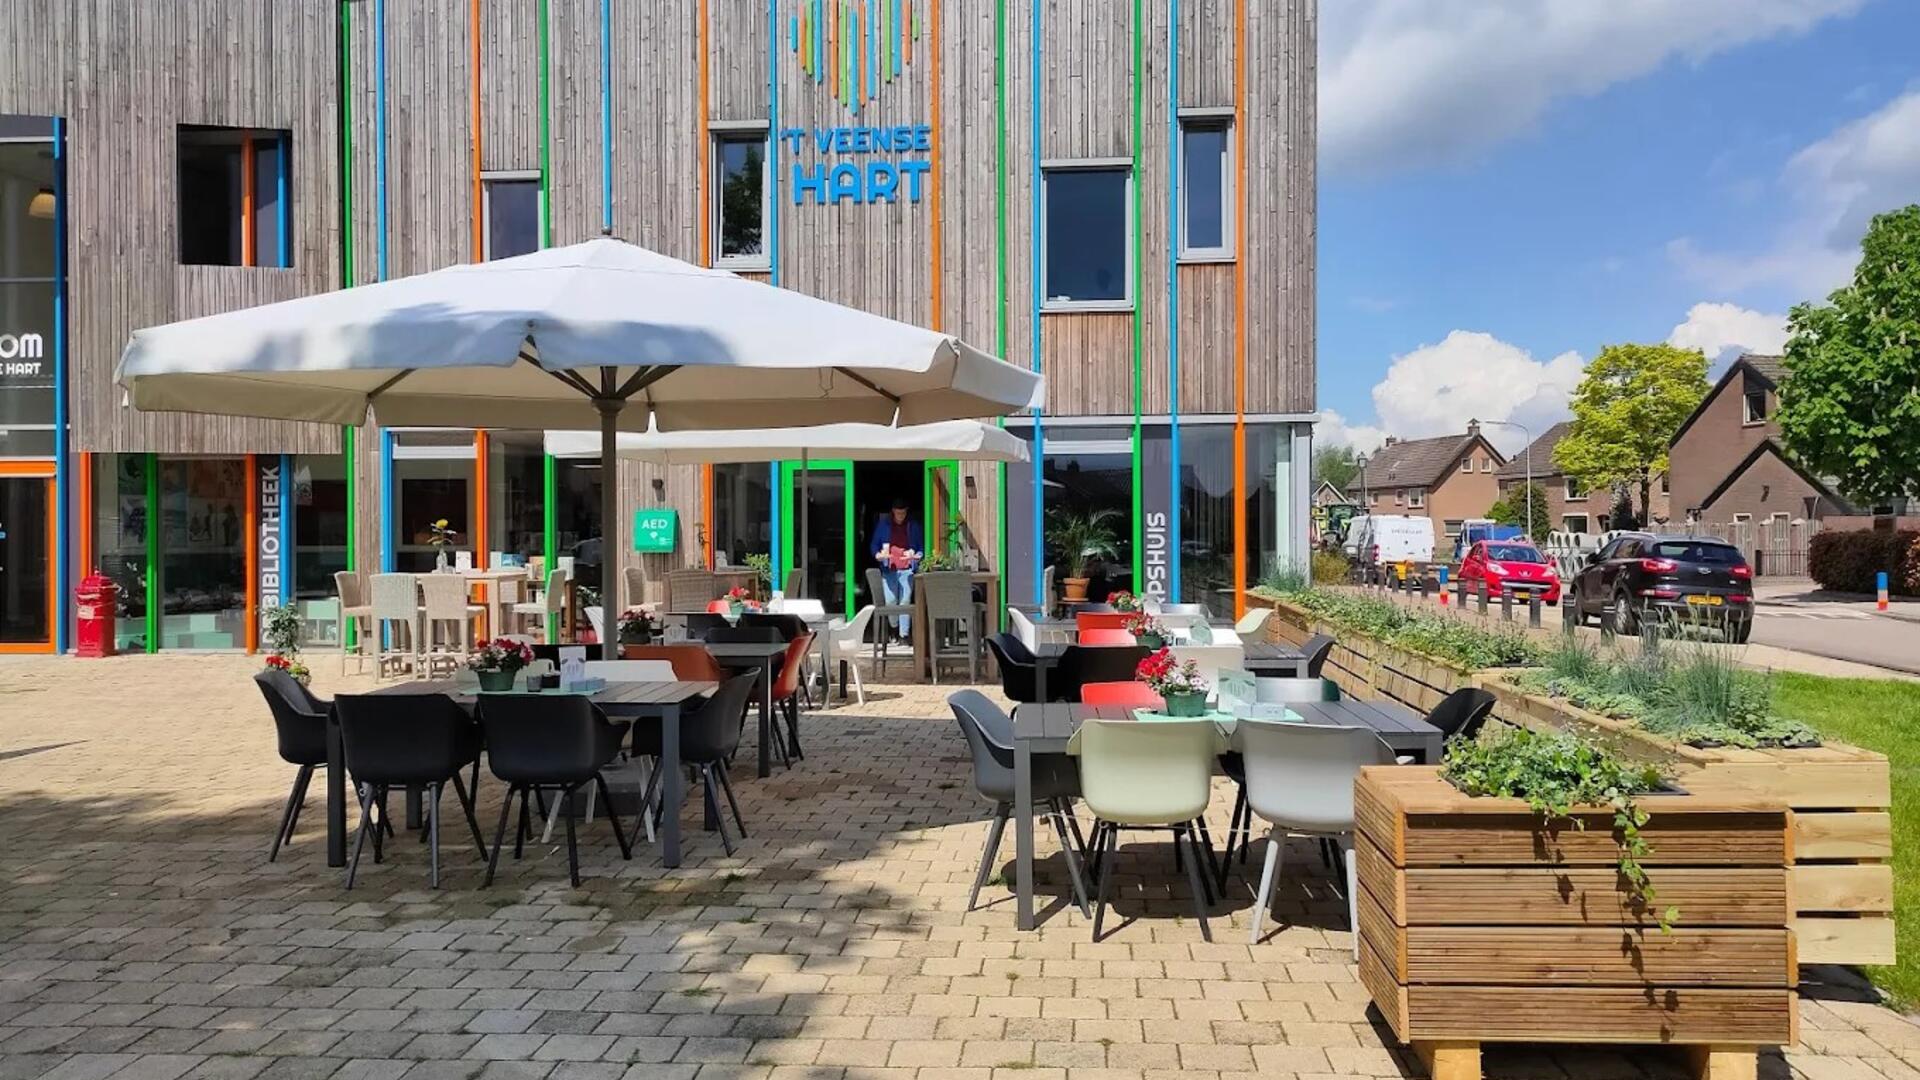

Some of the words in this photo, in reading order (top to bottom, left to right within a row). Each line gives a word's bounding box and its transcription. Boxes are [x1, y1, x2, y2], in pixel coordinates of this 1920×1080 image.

[815, 124, 931, 154] VEENSE
[792, 159, 931, 205] HART
[6, 362, 42, 375] HART
[262, 466, 279, 609] BIBLIOTHEEK
[641, 518, 668, 529] AED
